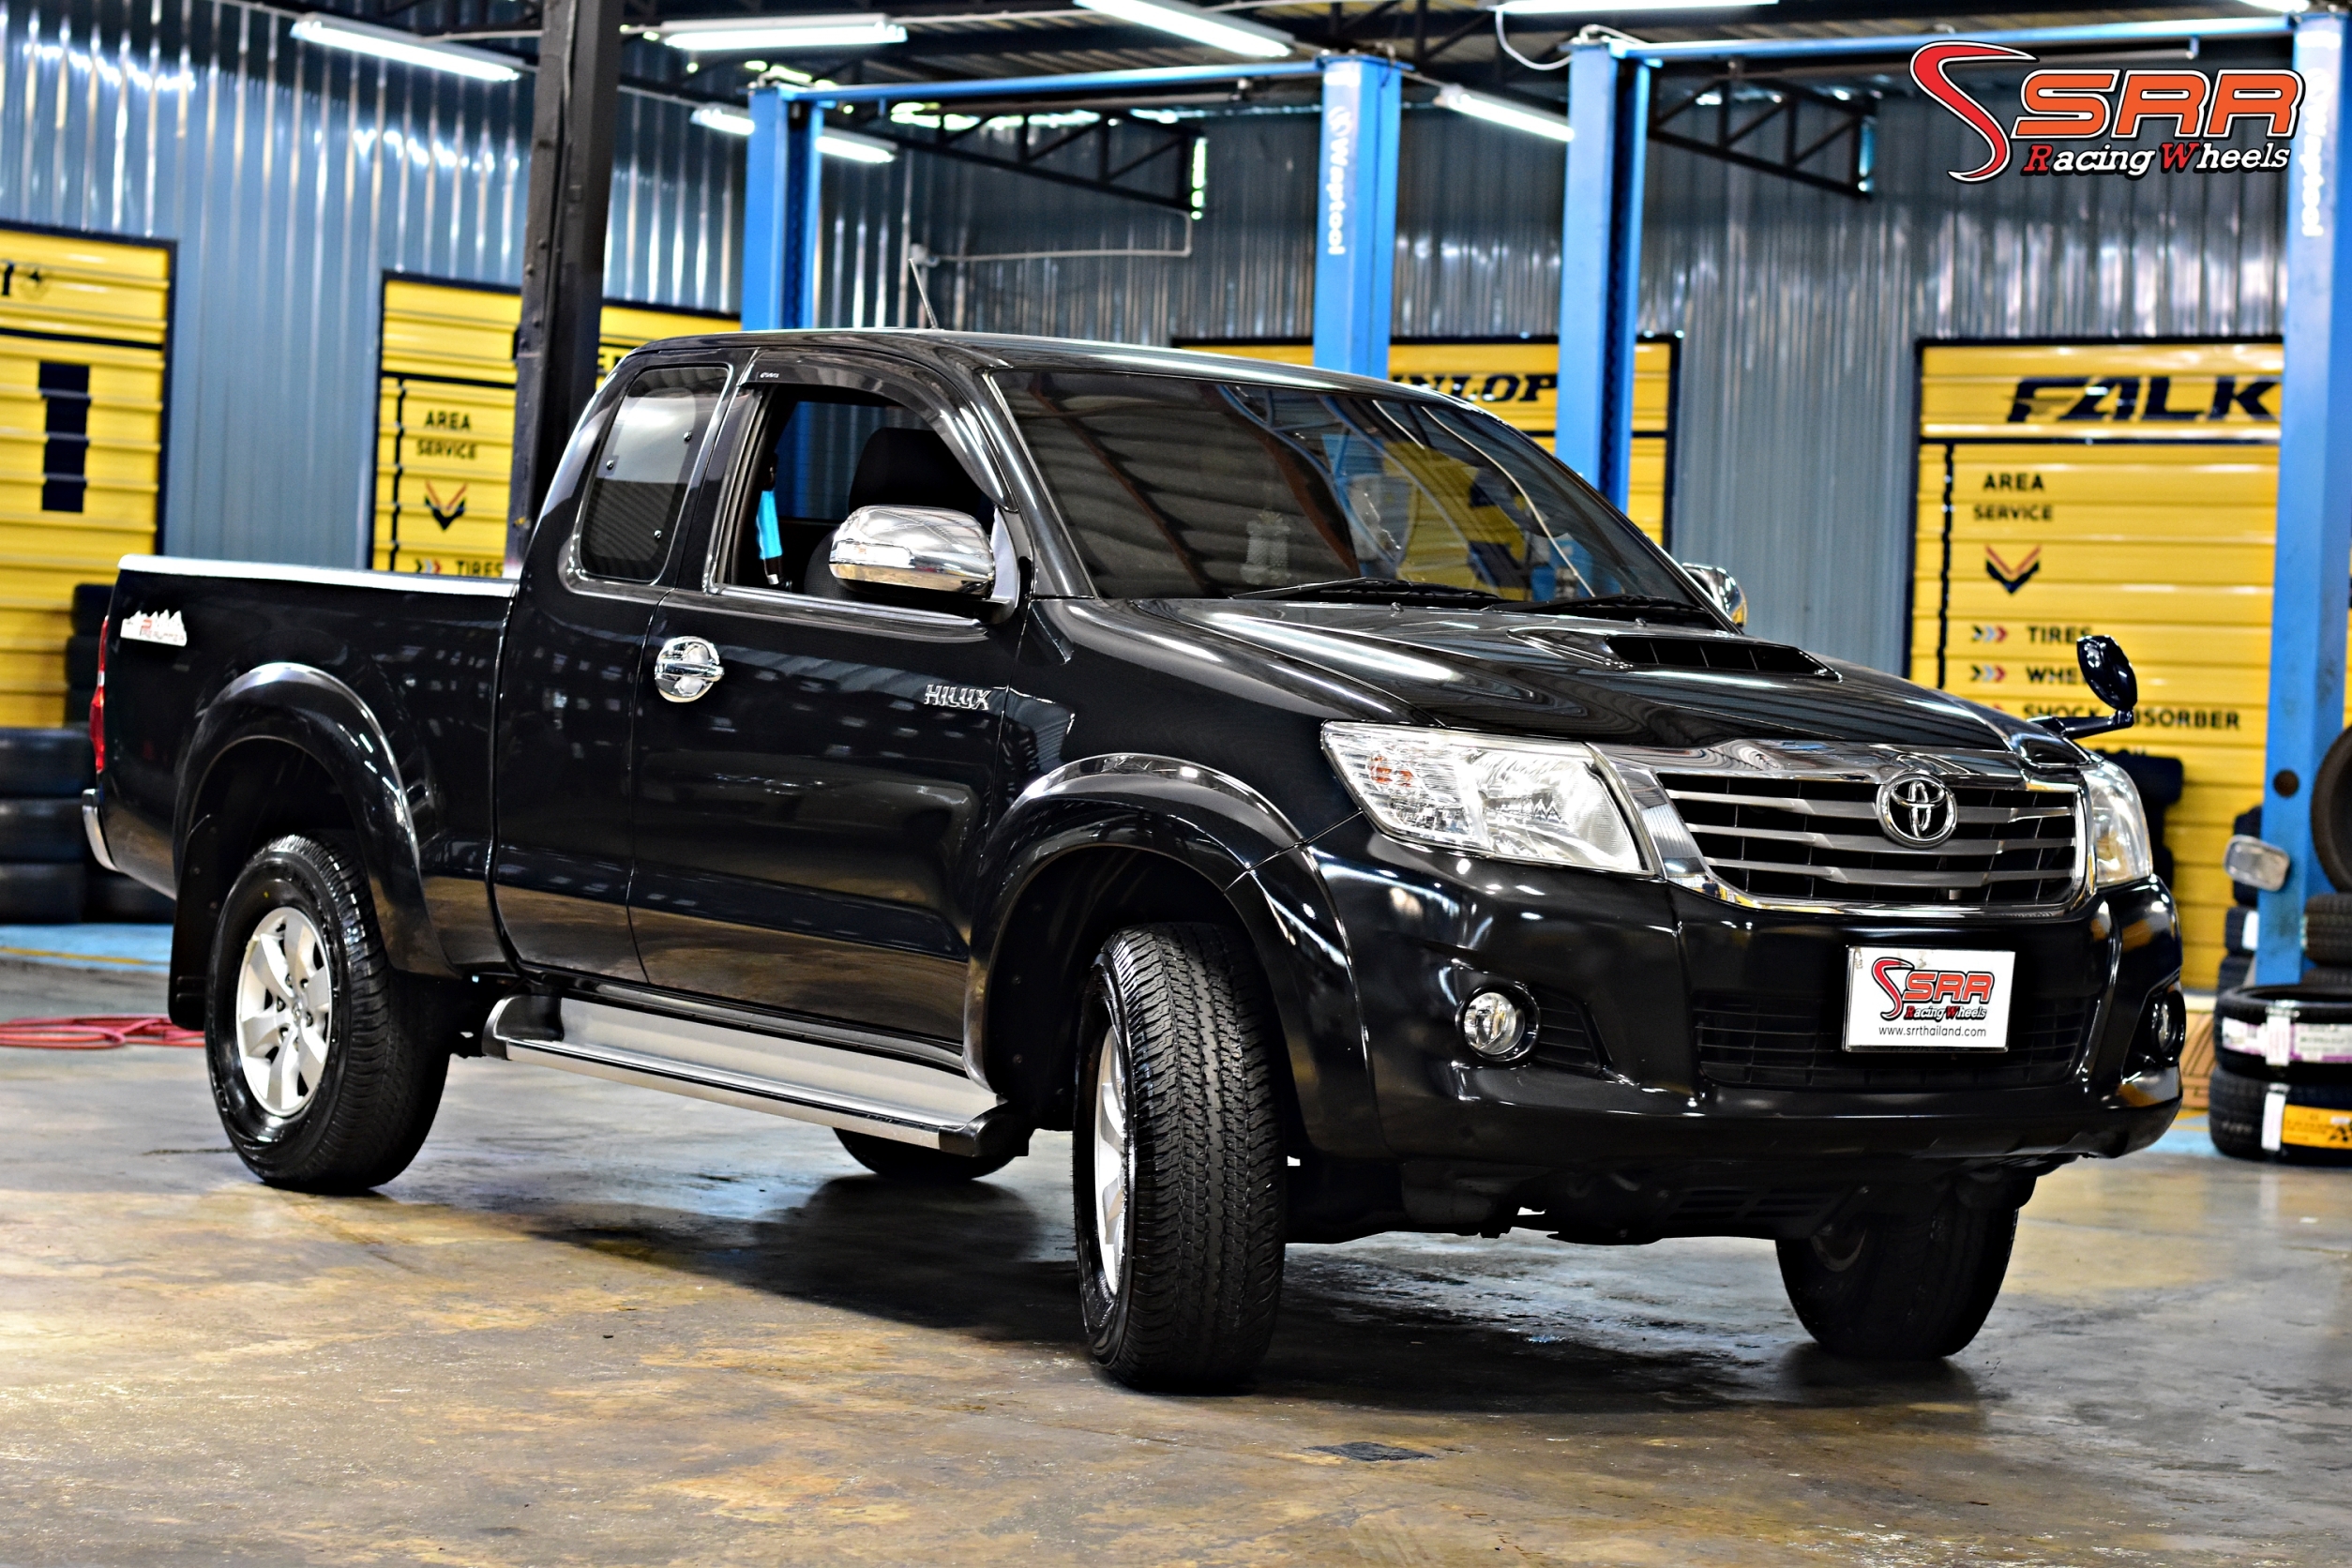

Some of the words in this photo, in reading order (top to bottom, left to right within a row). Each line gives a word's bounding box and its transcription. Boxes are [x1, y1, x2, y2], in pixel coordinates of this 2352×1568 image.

[1392, 373, 1558, 402] NLOP
[425, 410, 472, 431] AREA
[416, 439, 478, 460] SERVICE
[1983, 473, 2044, 492] AREA
[1973, 504, 2053, 522] SERVICE
[924, 684, 992, 711] HILUX
[1904, 1005, 1946, 1021] Racing
[1946, 1004, 1987, 1019] Wheels
[1878, 1025, 1987, 1037] www.srrthailand.com
